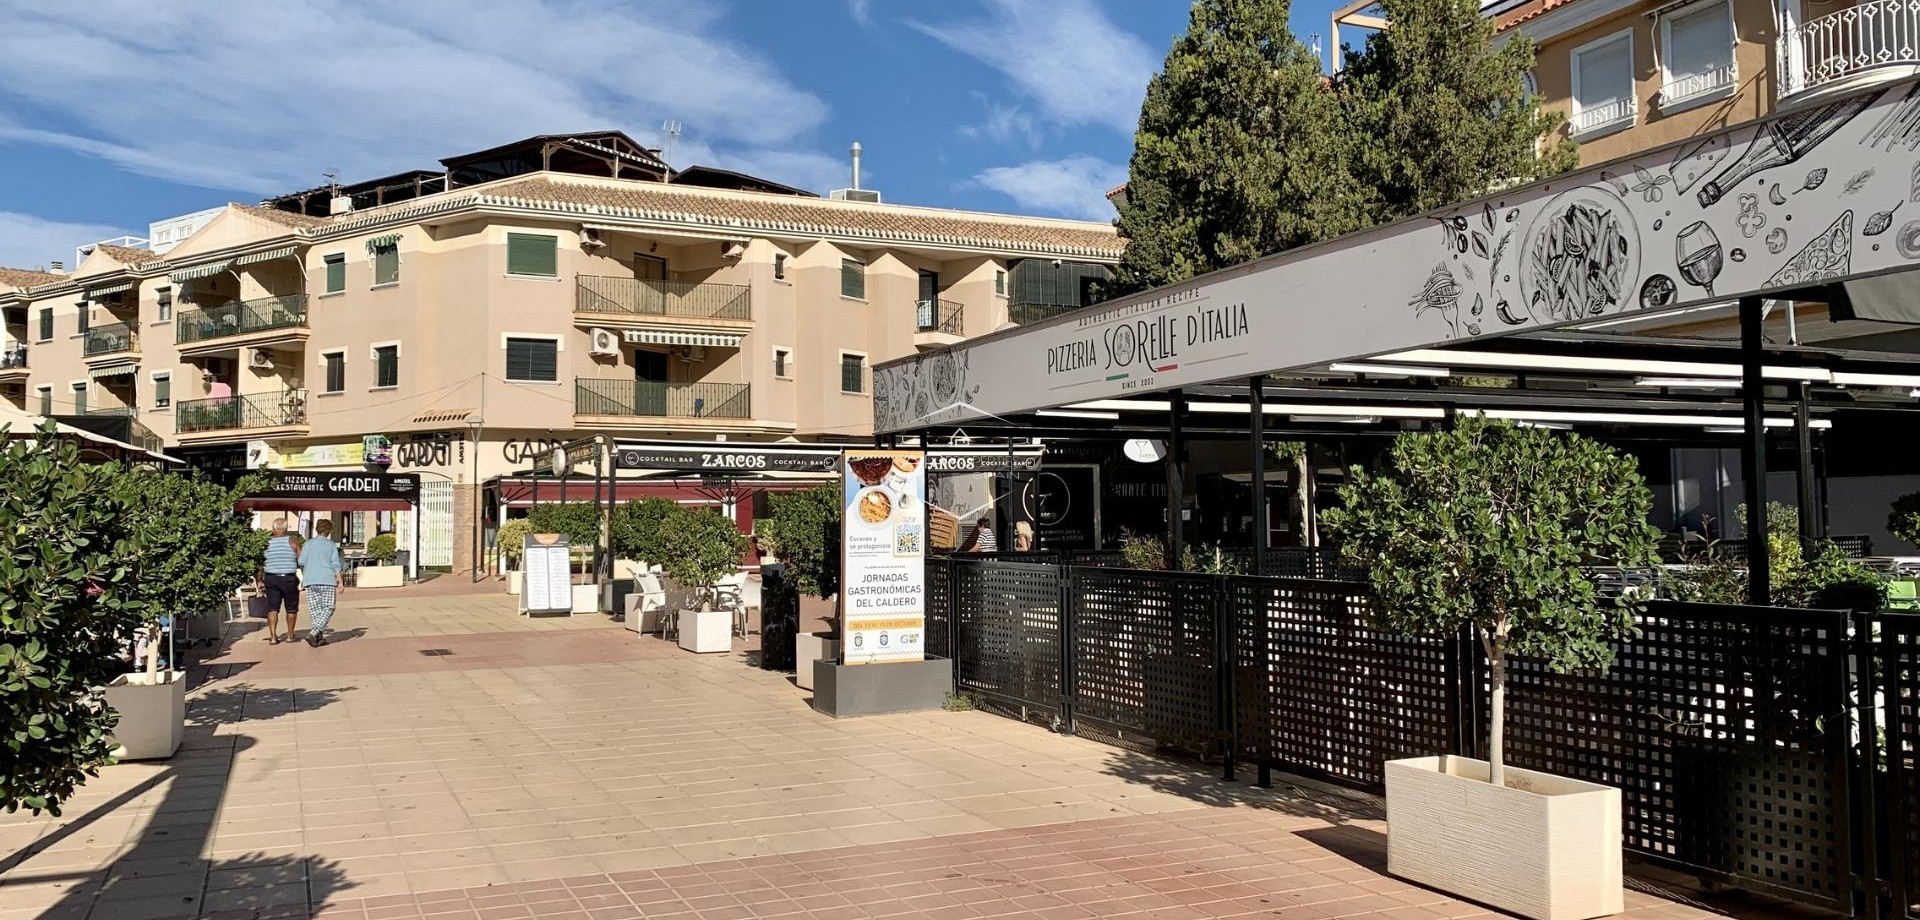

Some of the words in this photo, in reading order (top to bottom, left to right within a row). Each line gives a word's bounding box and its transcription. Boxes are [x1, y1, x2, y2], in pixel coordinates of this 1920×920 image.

[1079, 309, 1121, 327] AUTHENTIC
[1126, 299, 1161, 315] ITALIAN
[1167, 287, 1200, 304] RECIPE
[1047, 338, 1097, 375] PIZZERIA
[1104, 315, 1178, 373] SORELLE
[1187, 302, 1249, 347] D'ITALIA
[1122, 380, 1137, 390] SINCE
[397, 441, 451, 468] GARDEN
[701, 454, 766, 468] ZARCOS
[927, 457, 975, 470] ARCOS
[285, 476, 316, 484] PIZZERIA
[328, 477, 380, 492] GARDEN
[276, 483, 324, 492] RESTAURANTE
[861, 573, 909, 583] JORNADAS
[847, 584, 922, 596] GASTRONÓMICAS
[856, 598, 873, 608] DEL
[875, 597, 917, 607] CALDERO
